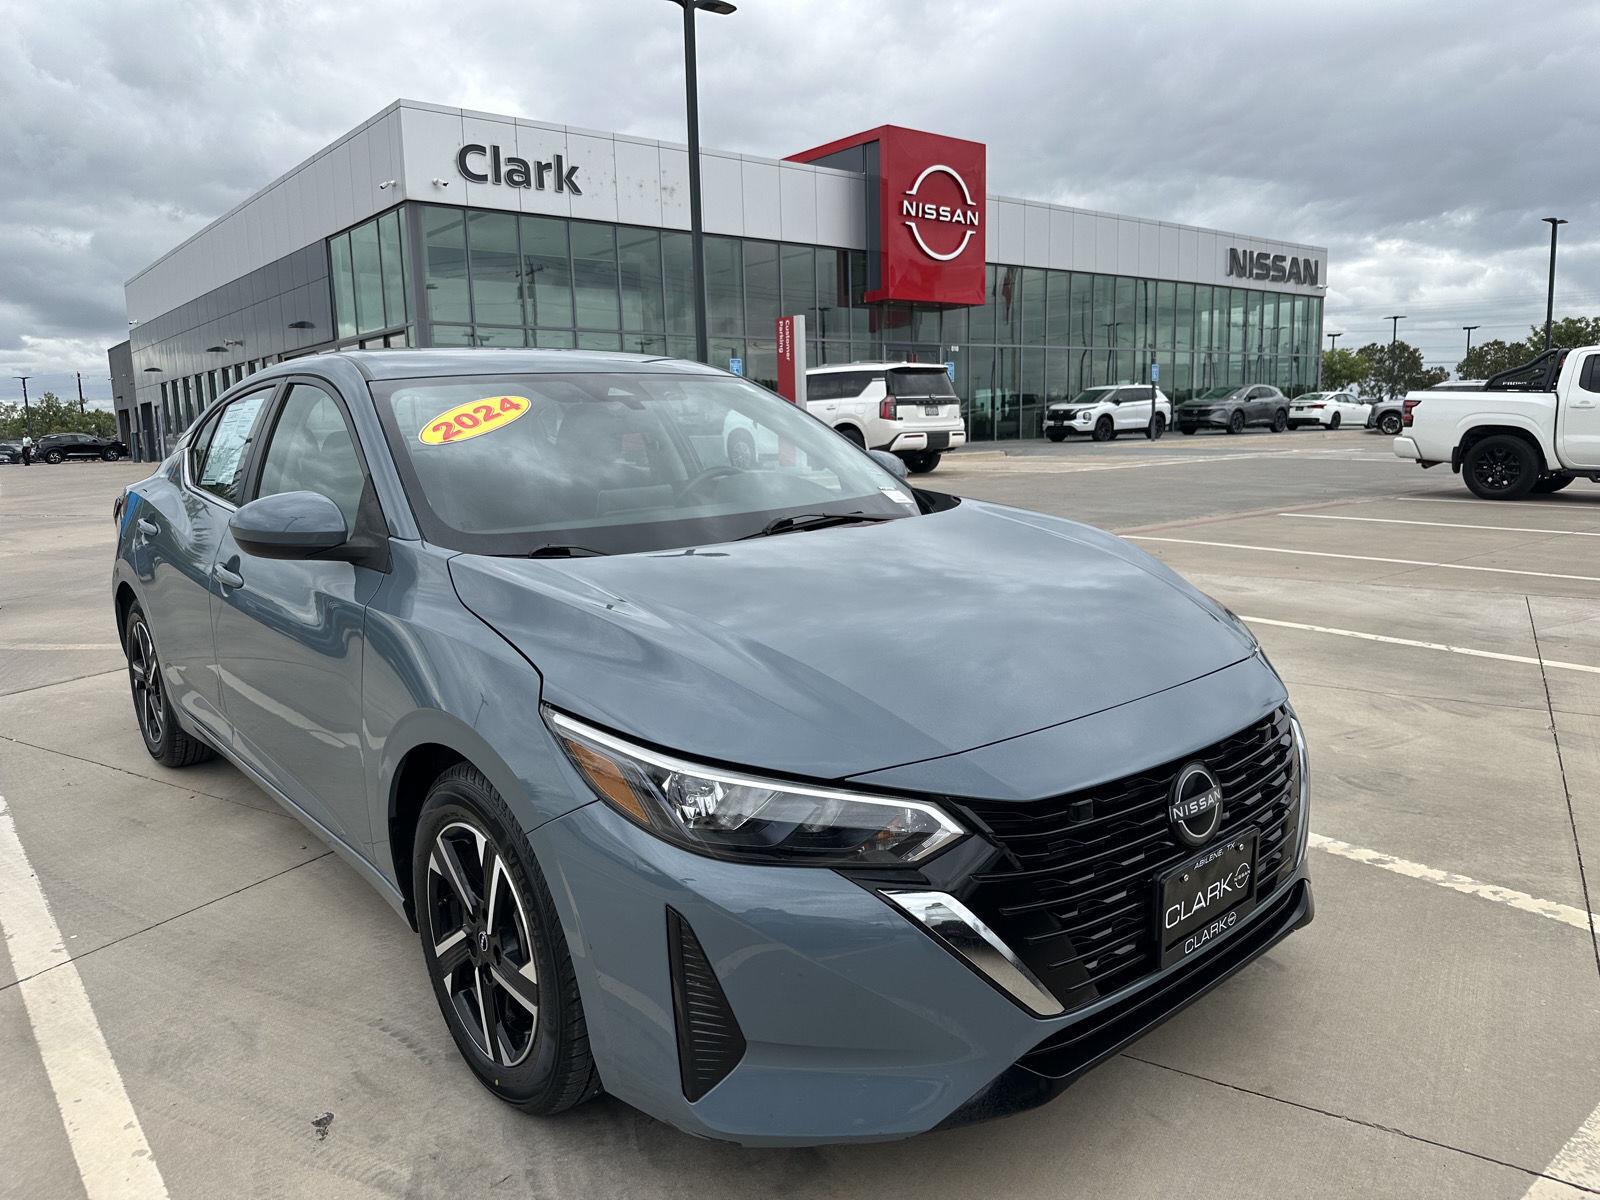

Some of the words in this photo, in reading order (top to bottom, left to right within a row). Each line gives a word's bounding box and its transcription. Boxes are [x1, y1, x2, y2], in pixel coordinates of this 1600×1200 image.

[456, 143, 583, 196] Clark
[903, 199, 979, 226] NISSAN
[1226, 247, 1319, 286] NISSAN
[432, 397, 522, 441] 2024
[1173, 788, 1221, 821] NISSAN
[1226, 841, 1236, 851] TX
[1165, 872, 1233, 929] CLARK
[1184, 916, 1228, 954] CLARK
